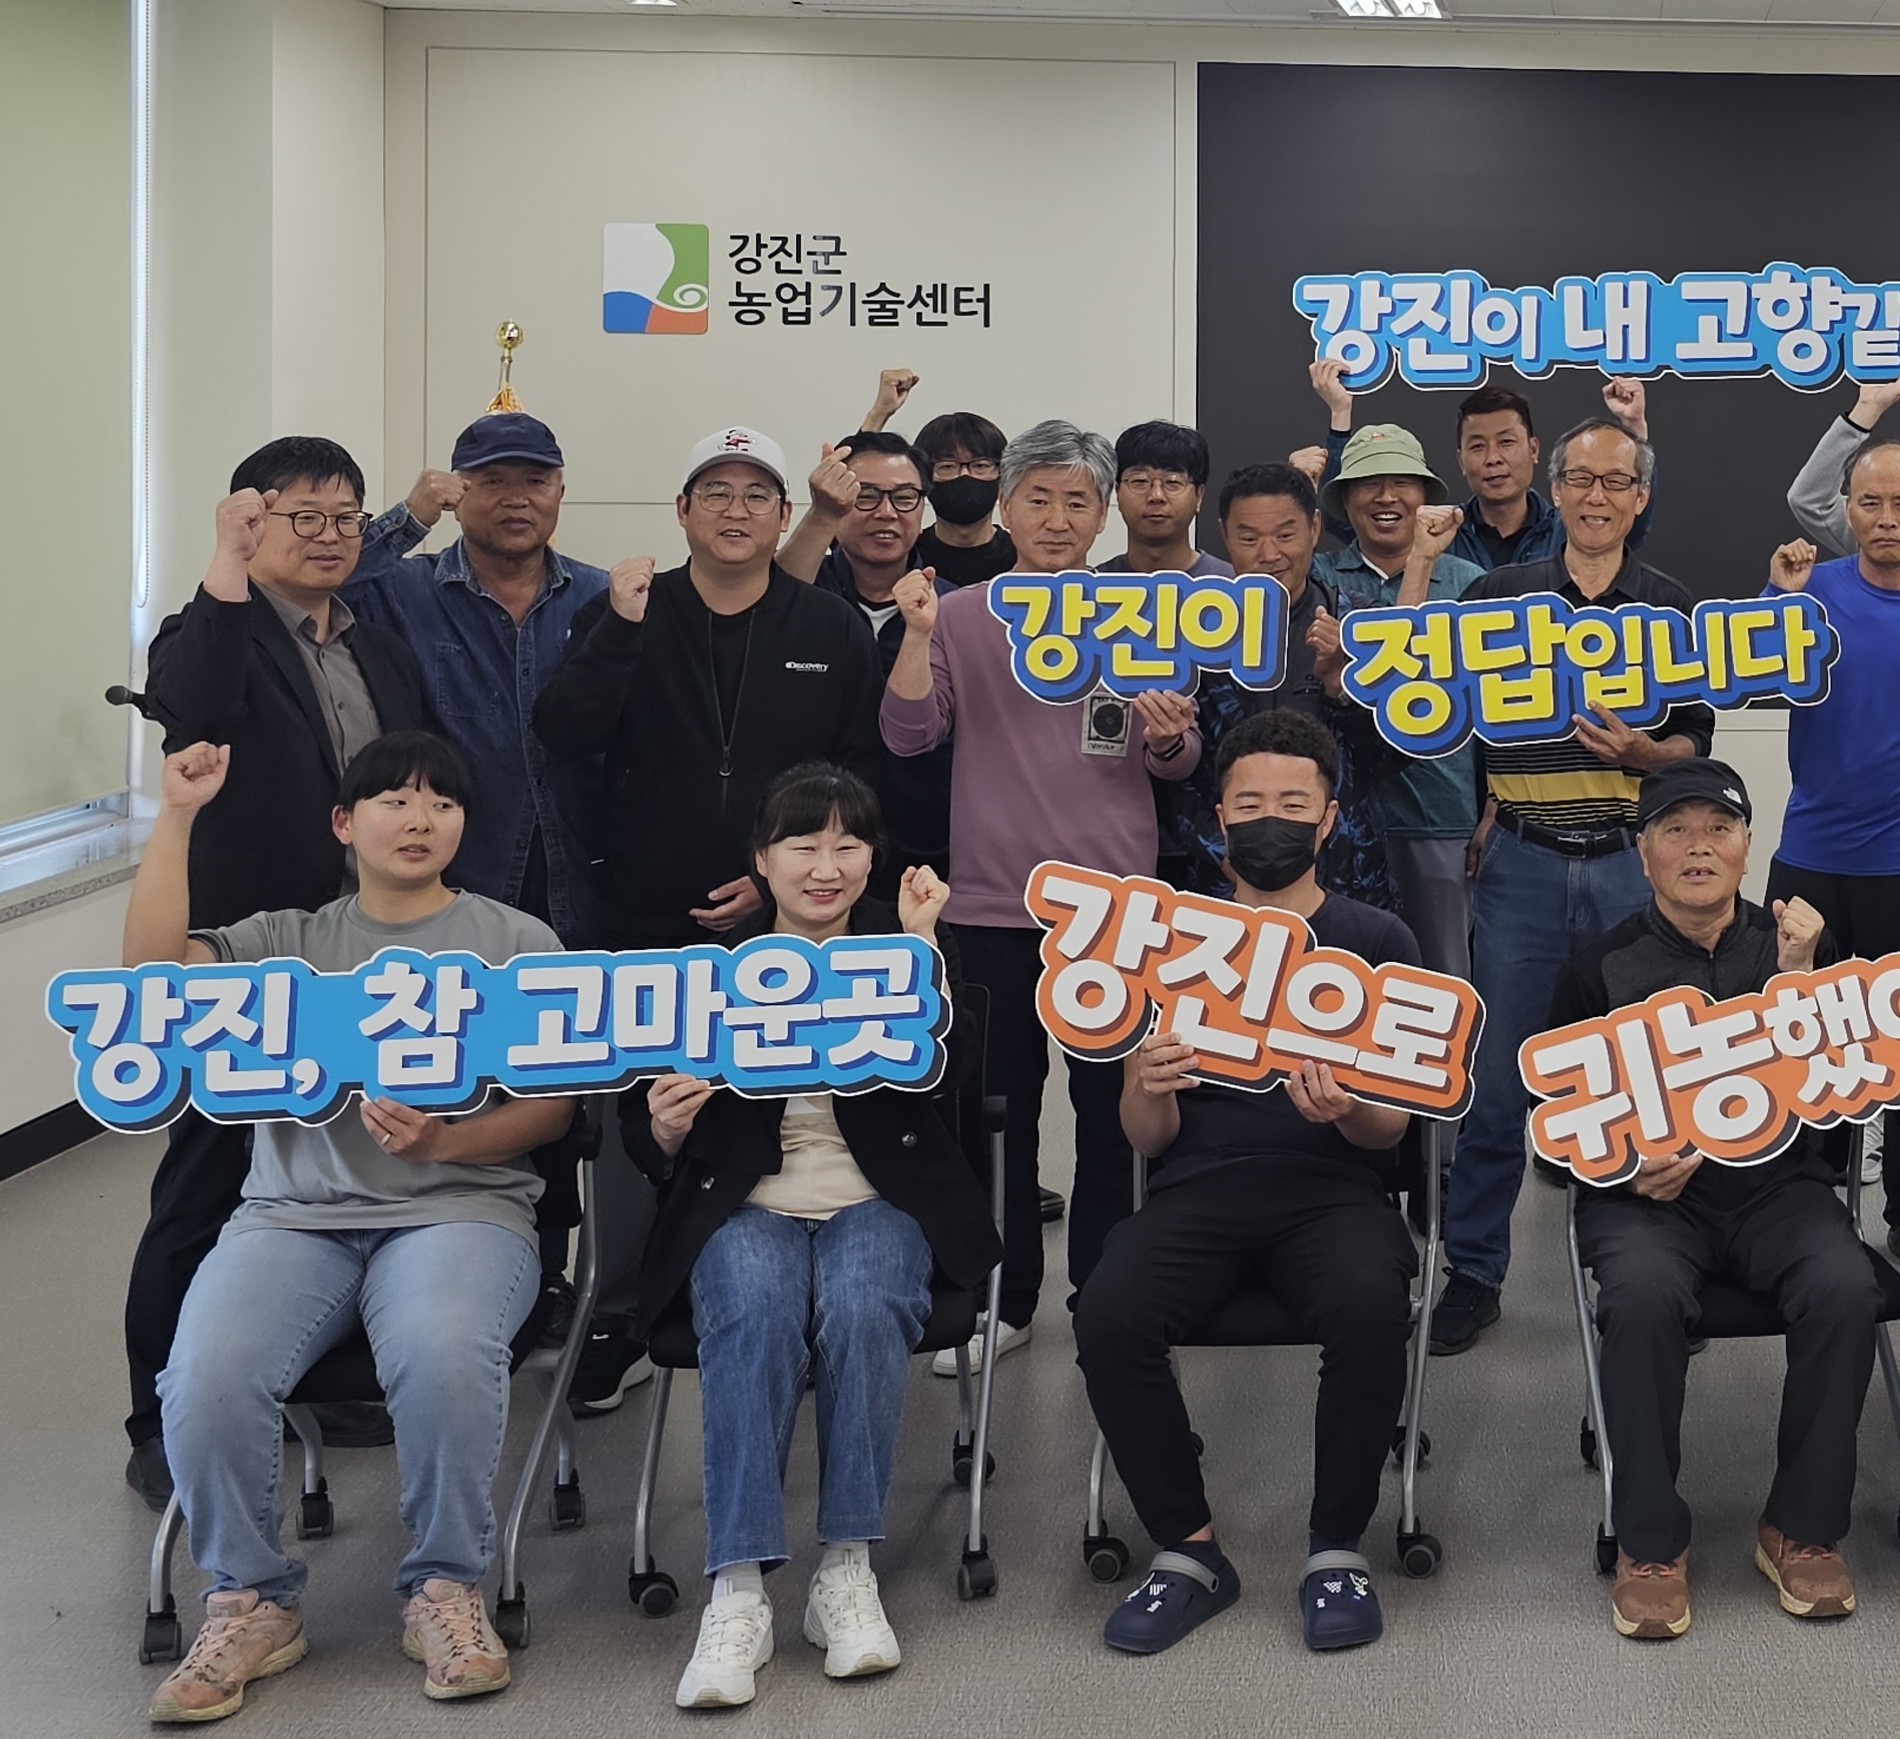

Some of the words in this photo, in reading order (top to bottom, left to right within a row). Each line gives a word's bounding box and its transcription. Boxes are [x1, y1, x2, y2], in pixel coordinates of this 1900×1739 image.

[728, 233, 847, 275] 강진군
[728, 281, 991, 328] 농업기술센터
[1303, 279, 1537, 373] 강진이
[1563, 281, 1645, 360] 내
[1002, 583, 1264, 681] 강진이
[1352, 604, 1816, 735] 정답입니다
[62, 971, 320, 1103] 강진,
[359, 960, 478, 1090] 참
[506, 948, 921, 1068] 고마운곳
[1040, 875, 1459, 1088] 강진으로
